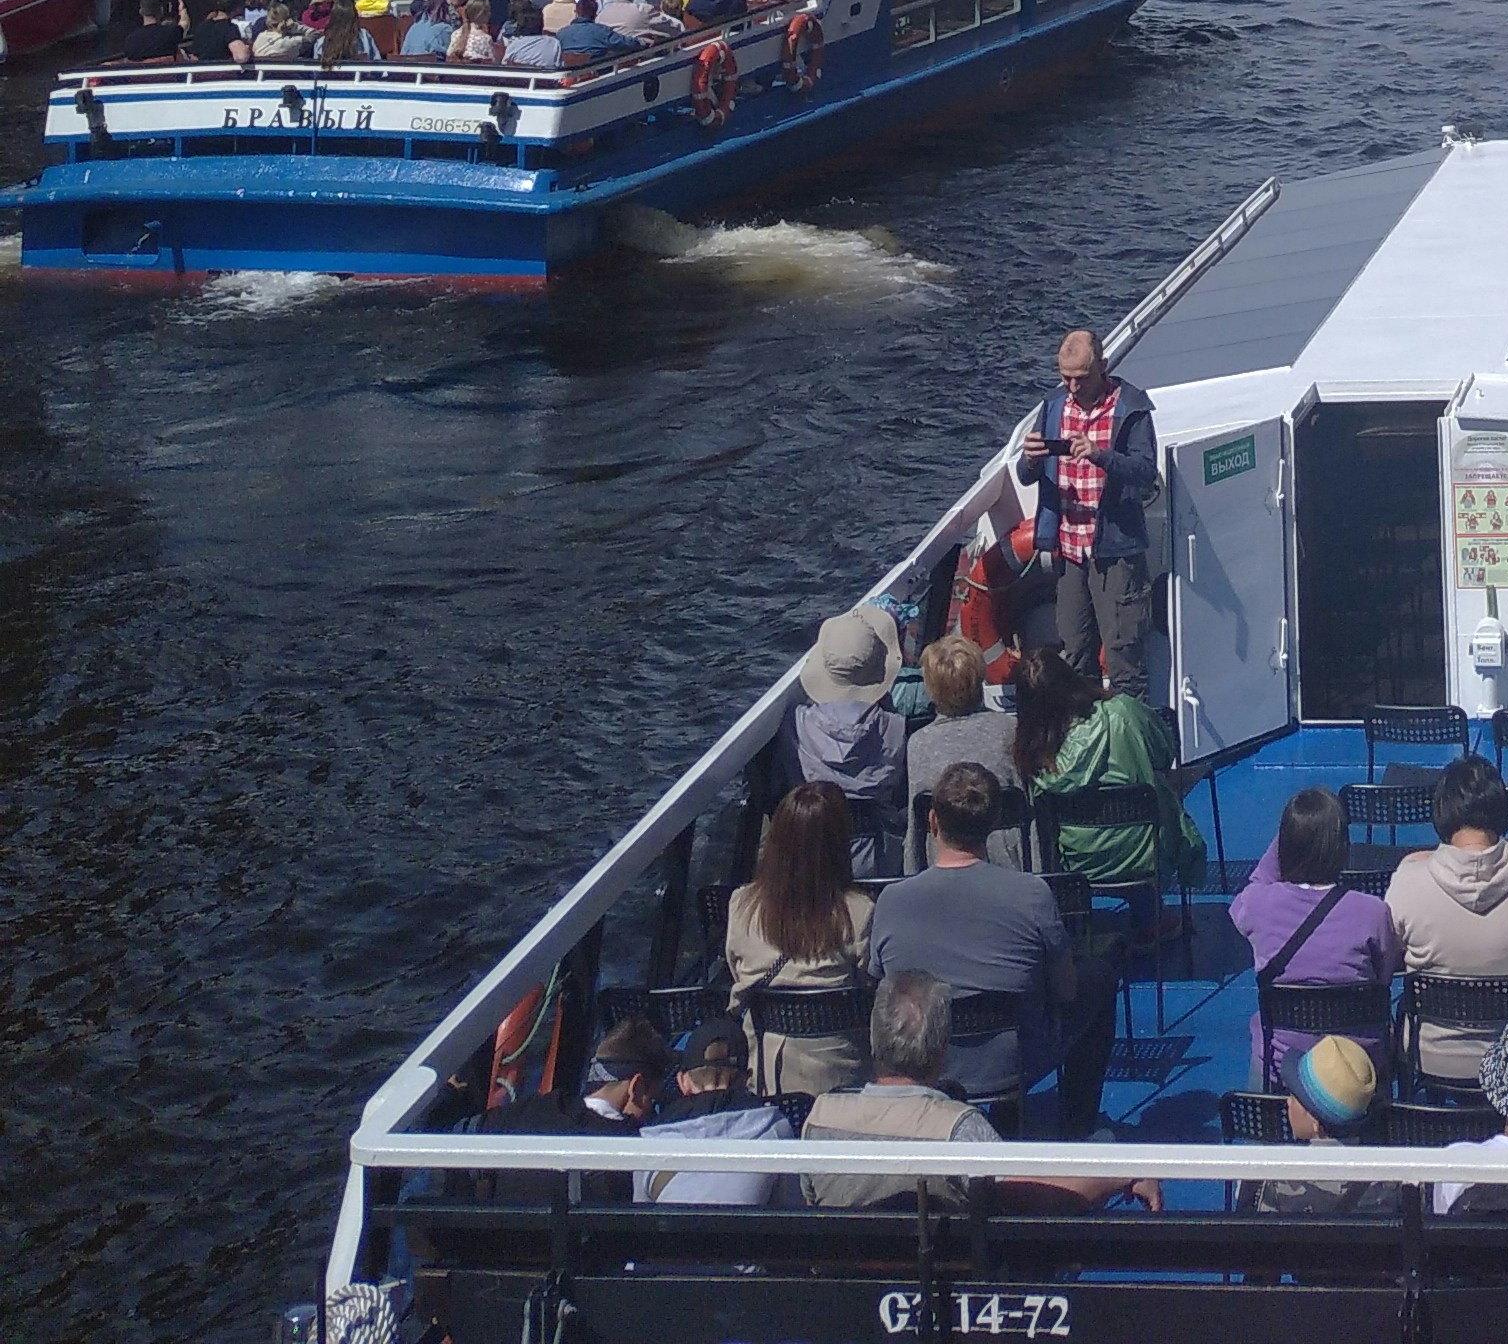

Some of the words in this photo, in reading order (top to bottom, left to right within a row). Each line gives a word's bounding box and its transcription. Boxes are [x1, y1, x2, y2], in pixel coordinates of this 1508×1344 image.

[222, 104, 376, 130] БРАВЫЙ
[1211, 451, 1250, 476] ВЫХОД
[956, 1293, 1070, 1338] 14-72
